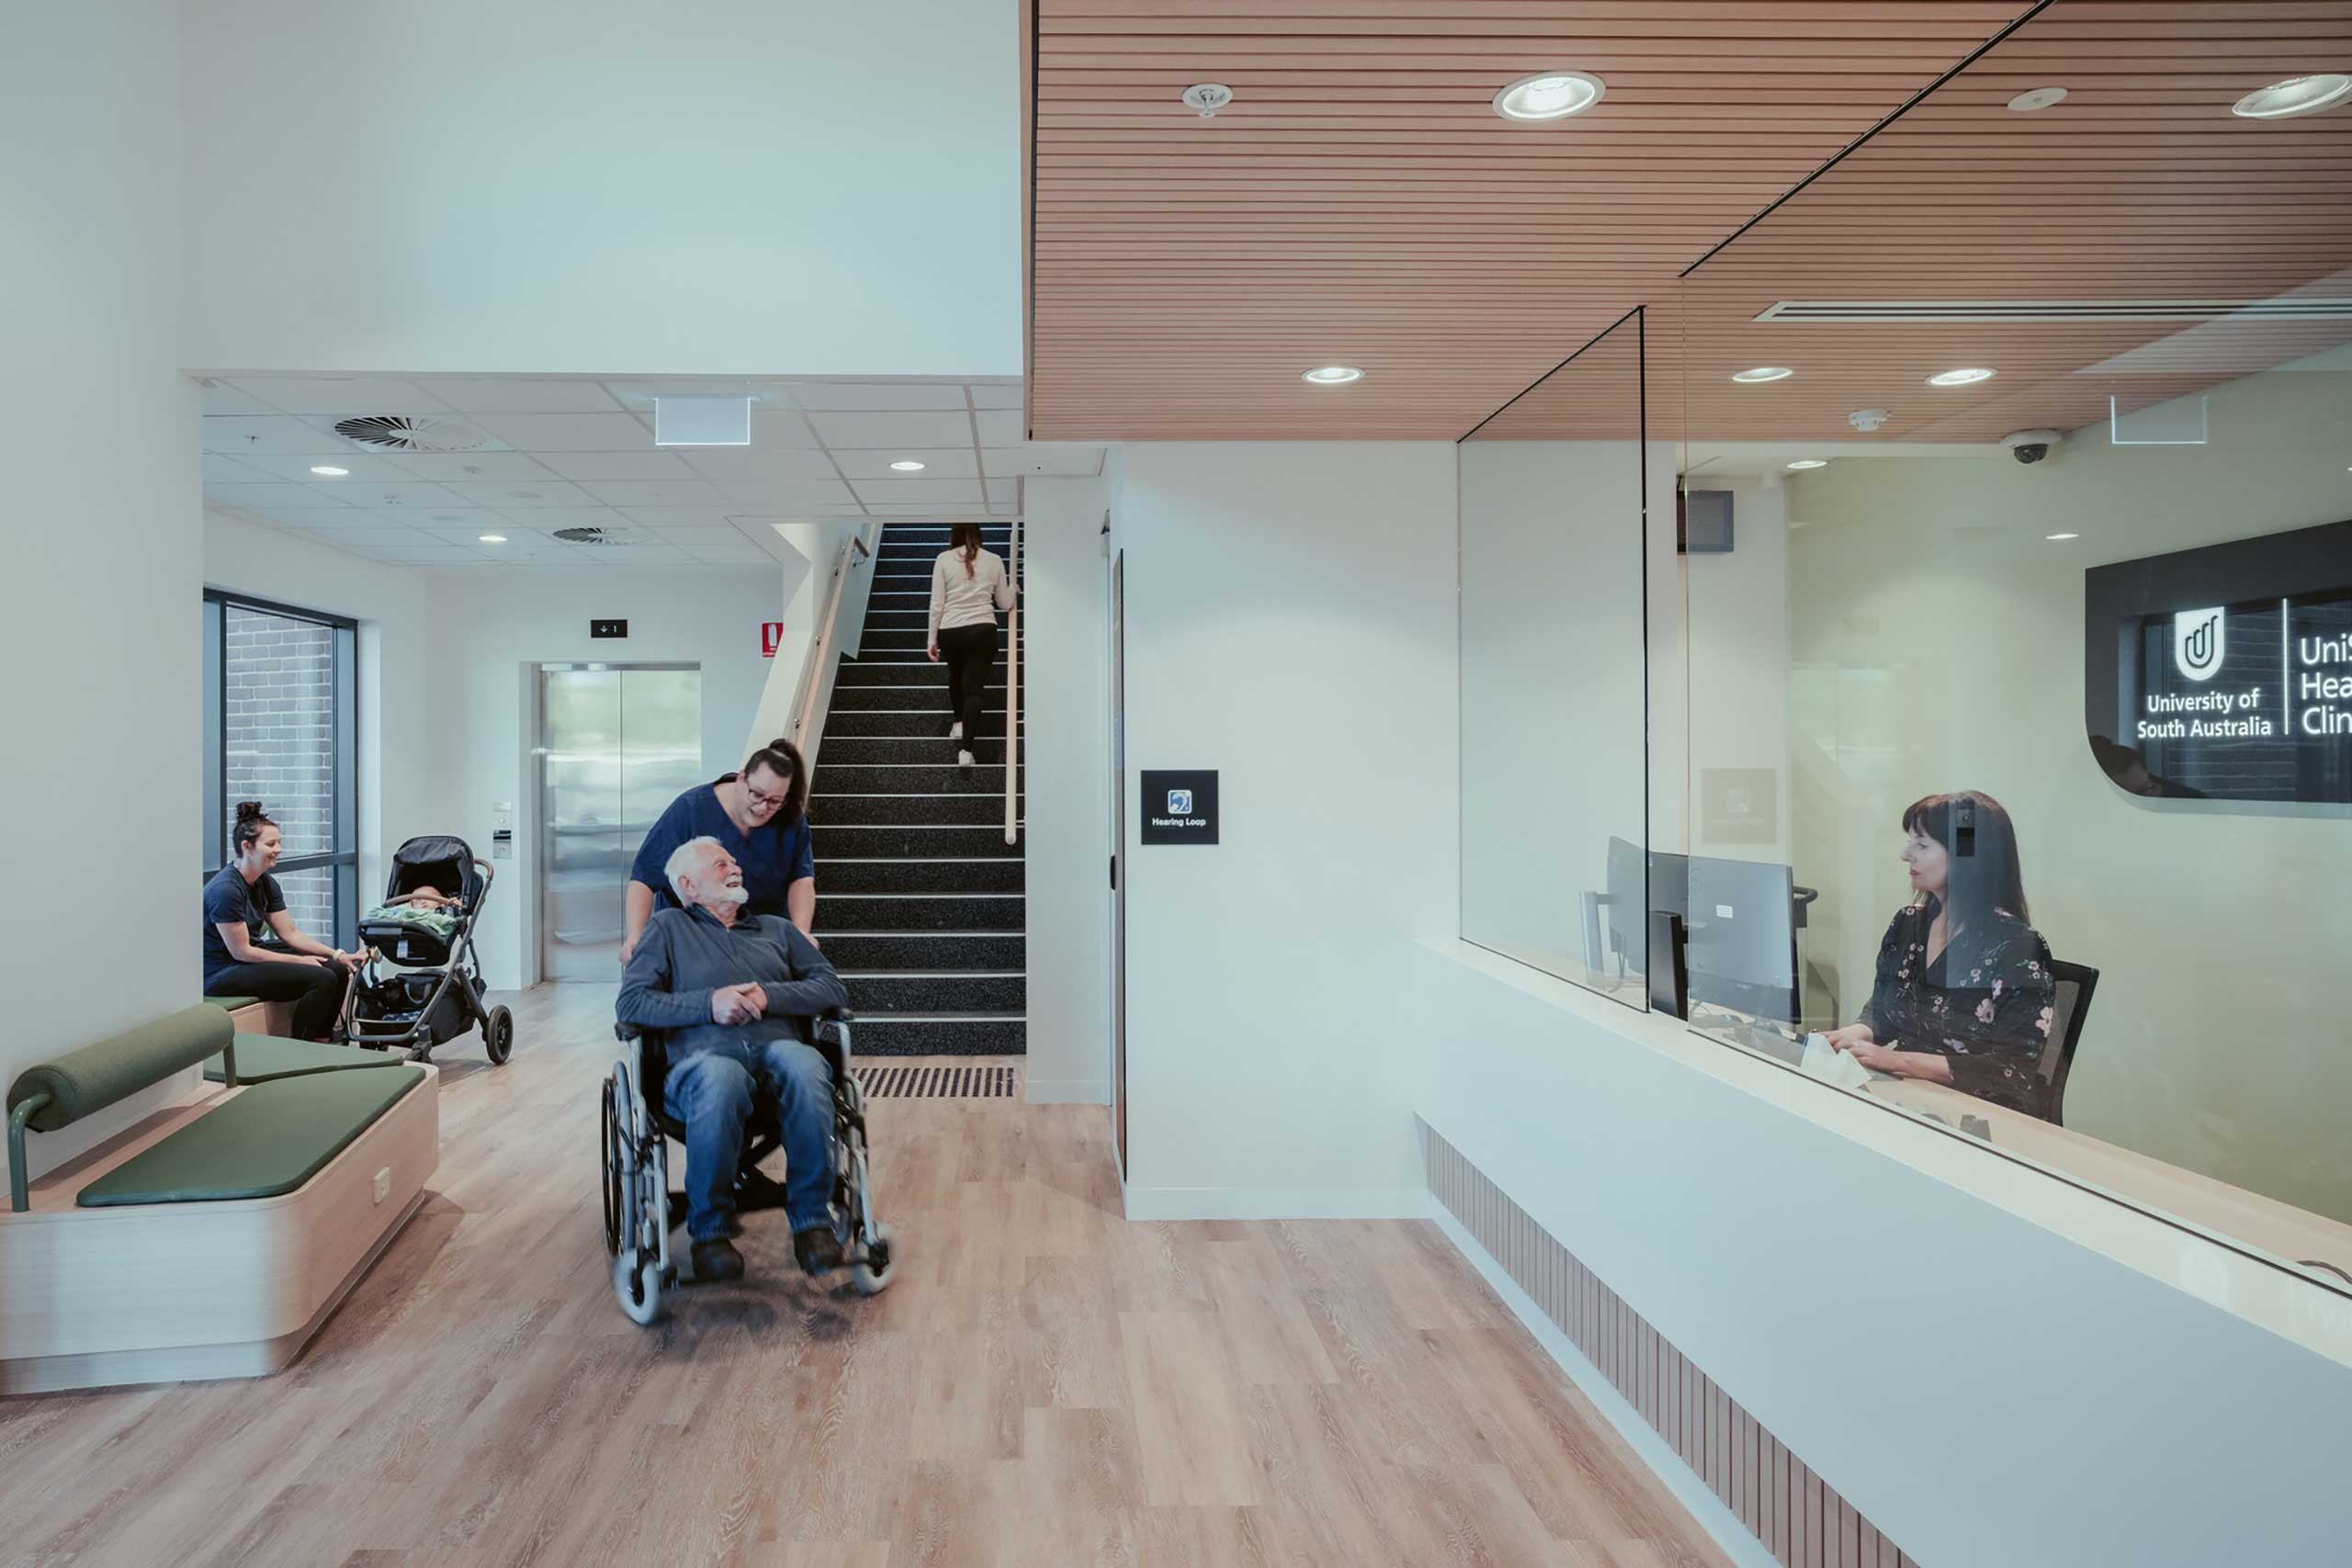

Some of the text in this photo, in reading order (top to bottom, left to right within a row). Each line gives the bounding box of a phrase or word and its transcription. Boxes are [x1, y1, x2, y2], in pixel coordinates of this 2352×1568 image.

[2301, 671, 2352, 700] Hea
[2147, 687, 2260, 714] University of
[2137, 716, 2272, 739] South Australia
[2301, 705, 2352, 735] Clin
[1152, 818, 1206, 827] Hearing Loop
